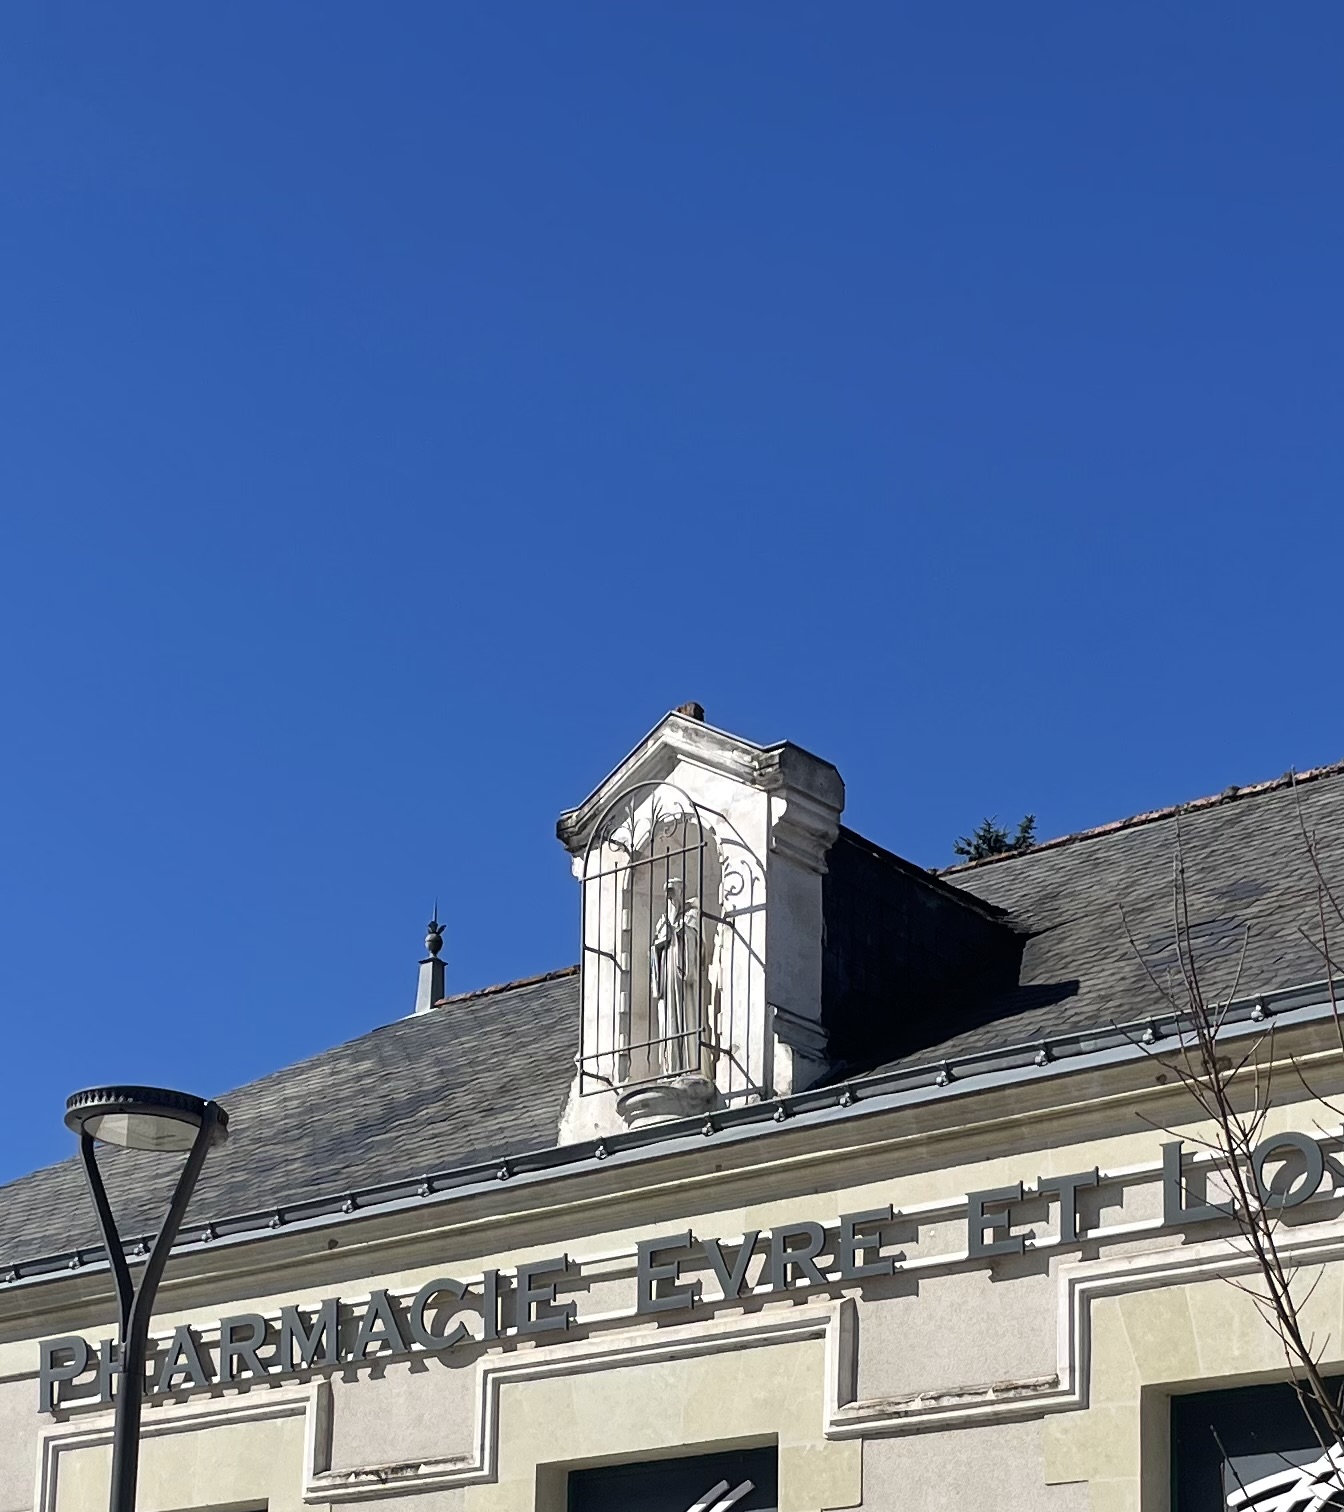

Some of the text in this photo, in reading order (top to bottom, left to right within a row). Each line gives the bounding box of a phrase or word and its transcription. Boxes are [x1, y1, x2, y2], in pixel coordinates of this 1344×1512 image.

[36, 1252, 578, 1414] PHARMACIE
[635, 1202, 896, 1315] EVRE
[964, 1165, 1100, 1259] ET
